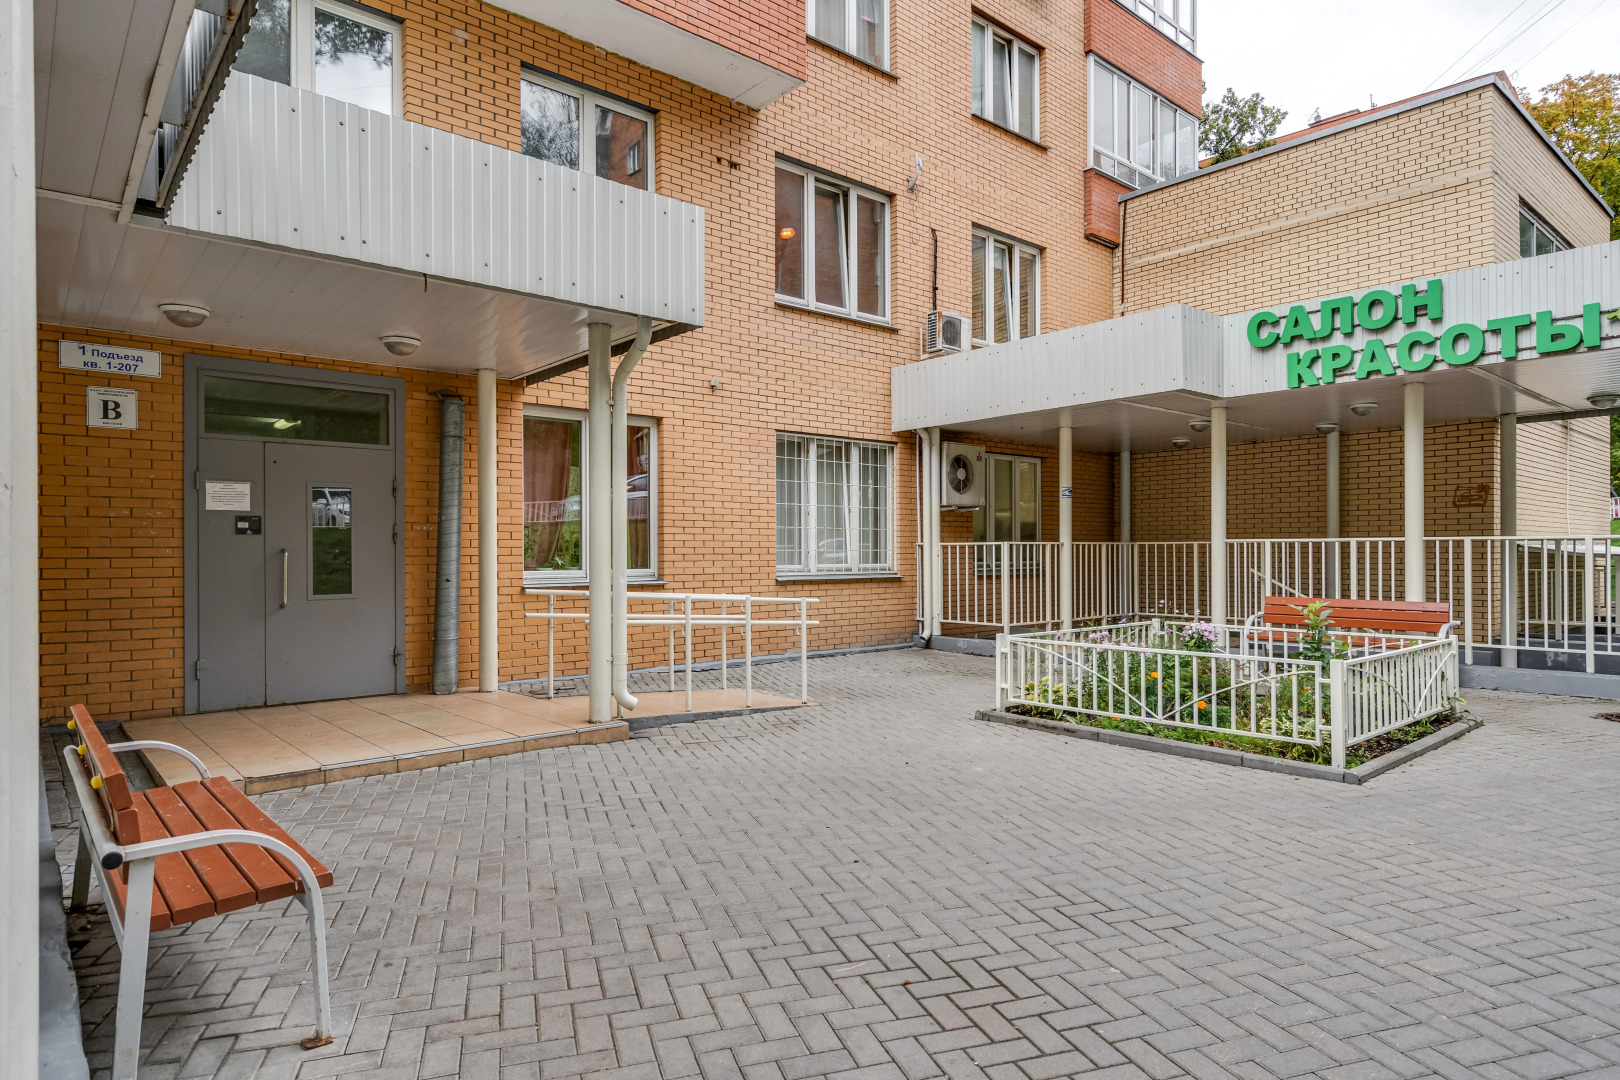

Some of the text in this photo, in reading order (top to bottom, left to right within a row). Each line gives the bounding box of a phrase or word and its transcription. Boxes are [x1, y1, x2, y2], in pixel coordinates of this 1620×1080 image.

[1246, 279, 1442, 348] САЛОН
[79, 345, 144, 363] 1 Подъезд
[1287, 302, 1601, 388] КРАСОТЫ
[83, 361, 139, 373] кв. 1-207
